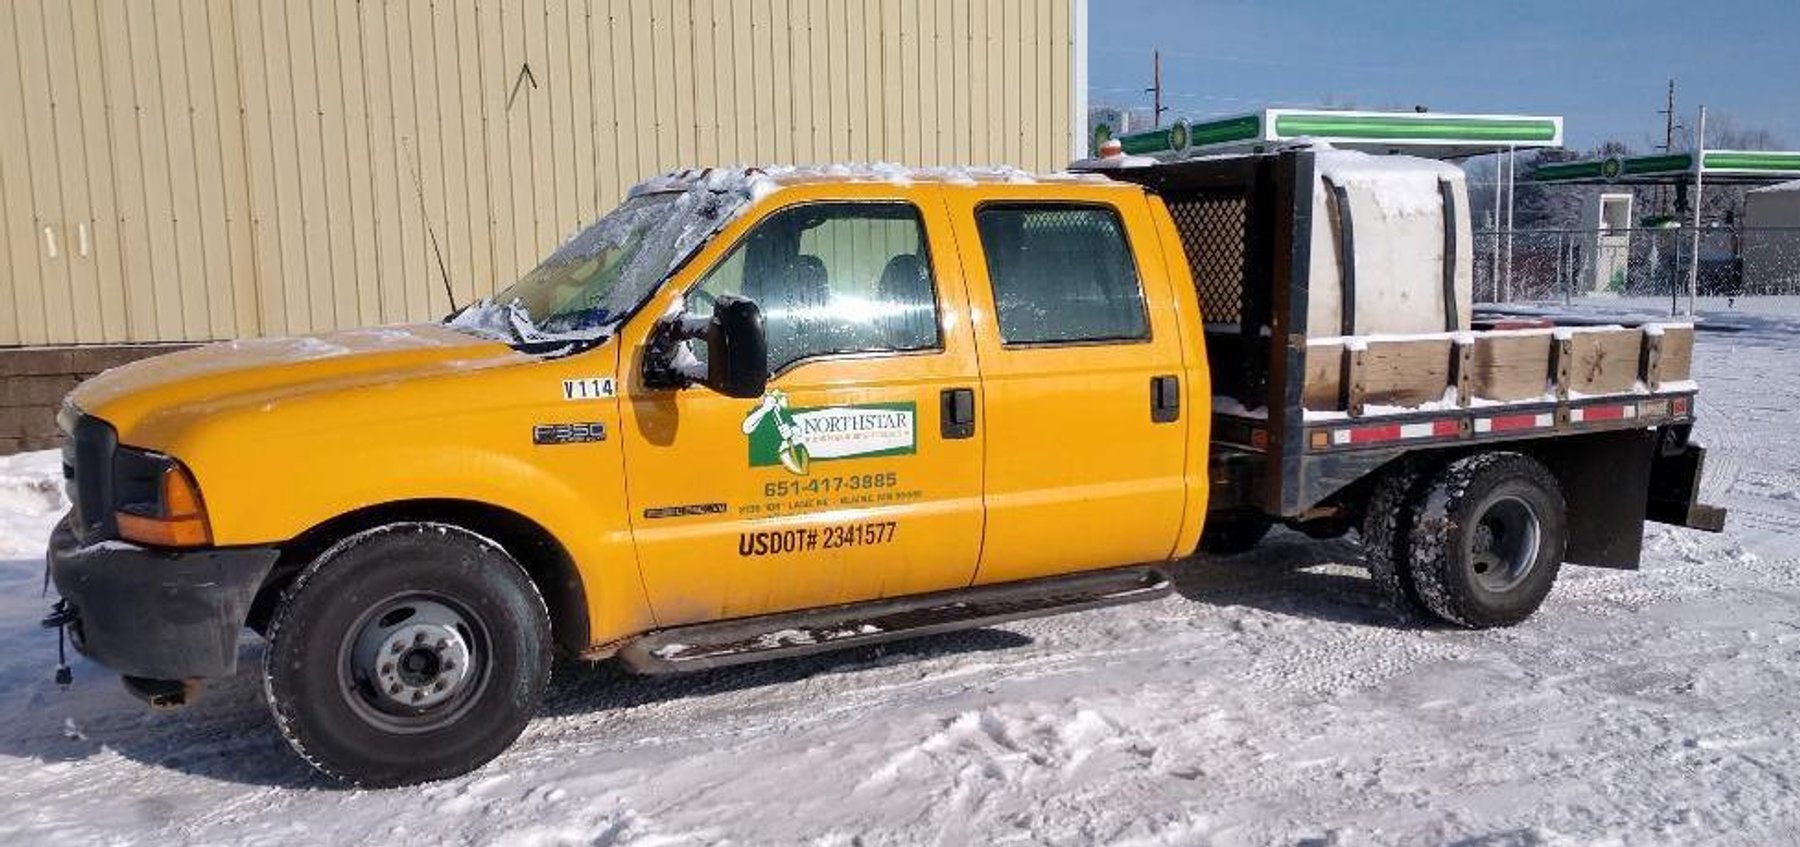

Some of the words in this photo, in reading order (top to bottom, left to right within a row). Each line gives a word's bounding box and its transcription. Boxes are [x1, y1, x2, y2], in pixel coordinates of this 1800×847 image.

[563, 380, 613, 398] V114
[804, 413, 907, 434] NORTHSTAR
[765, 472, 897, 497] 651-417-3885
[739, 528, 817, 556] USDOT#
[823, 522, 897, 548] 2341577
